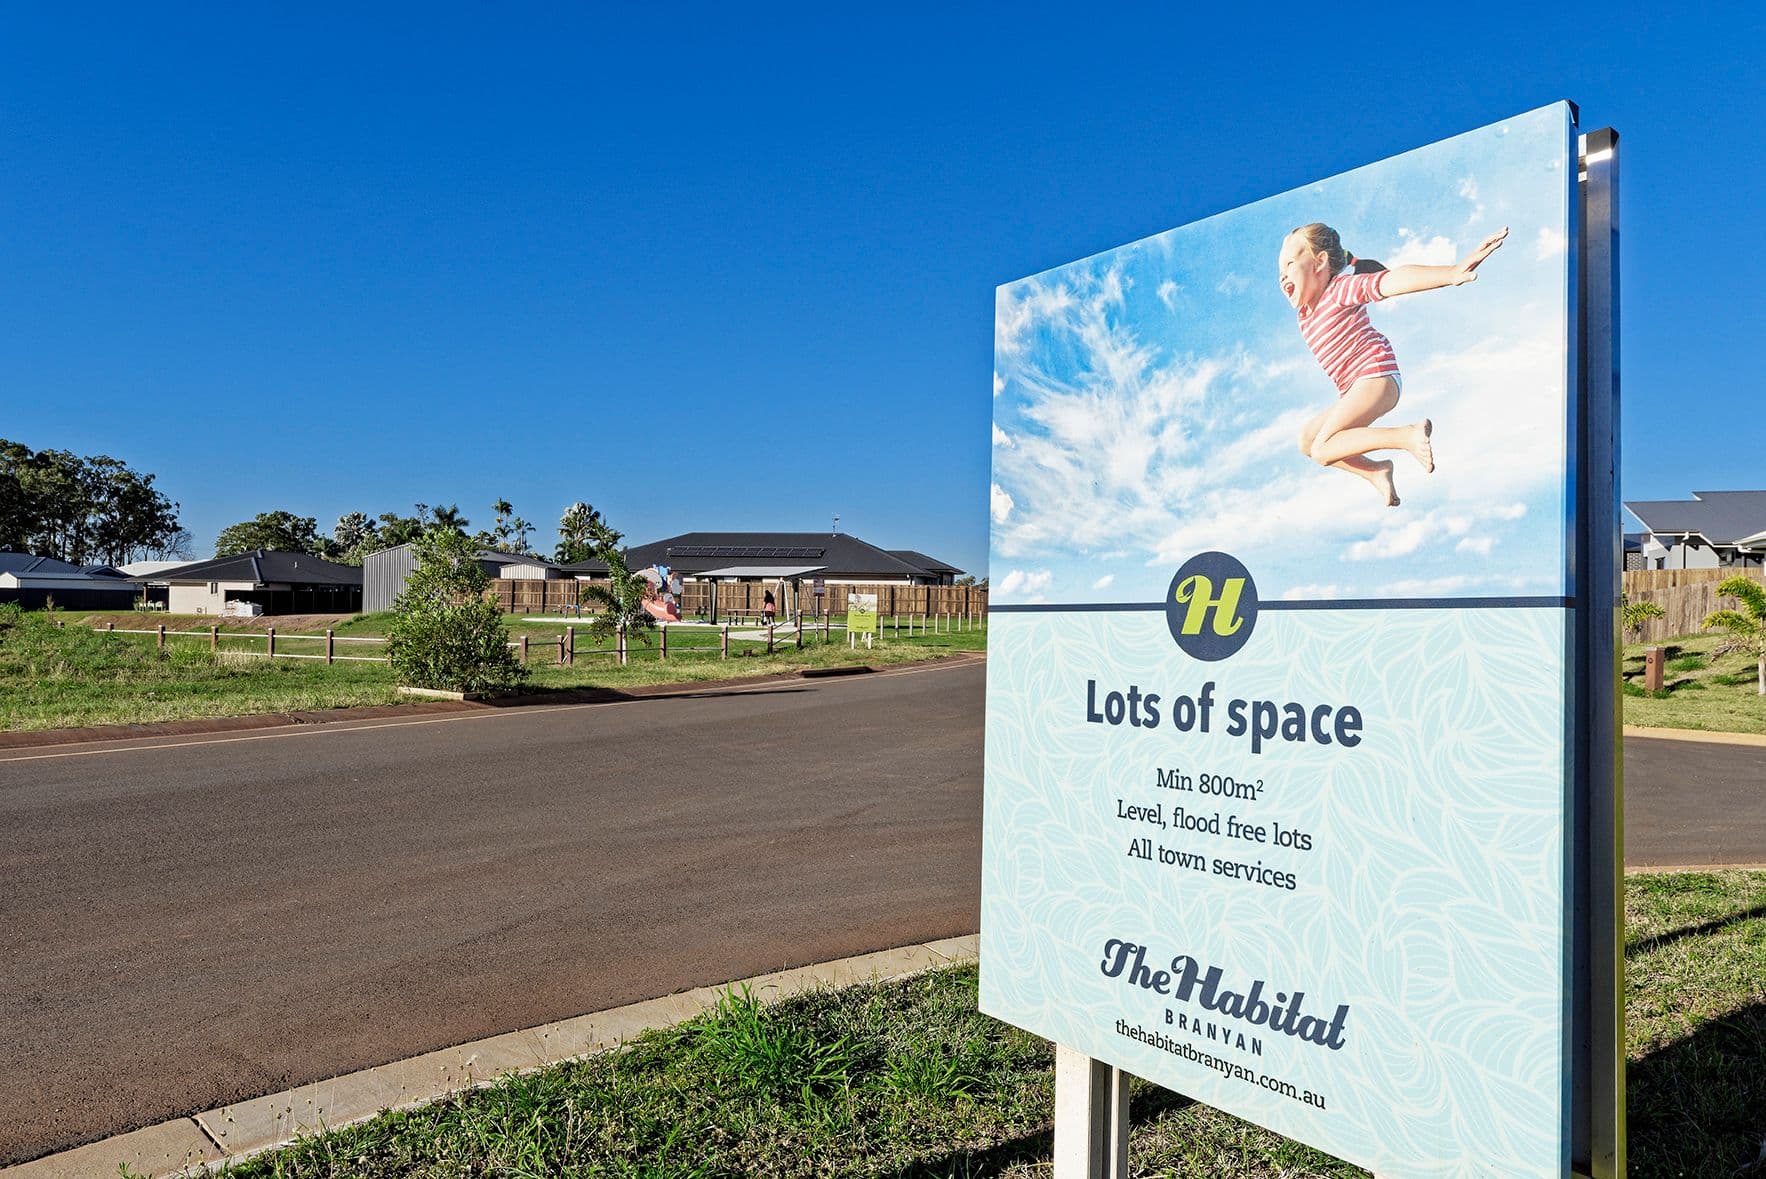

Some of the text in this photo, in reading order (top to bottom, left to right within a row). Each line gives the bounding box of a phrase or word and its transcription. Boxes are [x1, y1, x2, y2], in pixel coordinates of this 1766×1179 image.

[1175, 575, 1246, 637] H
[1086, 679, 1363, 755] Lots of space
[1156, 767, 1193, 792] Min
[1116, 799, 1313, 851] Level, flood free lots
[1127, 837, 1297, 891] All town services
[1100, 938, 1350, 1051] The Habitat
[1164, 1007, 1263, 1057] BRANYAN
[1115, 1018, 1327, 1111] thehabitatbranyan.com.au
